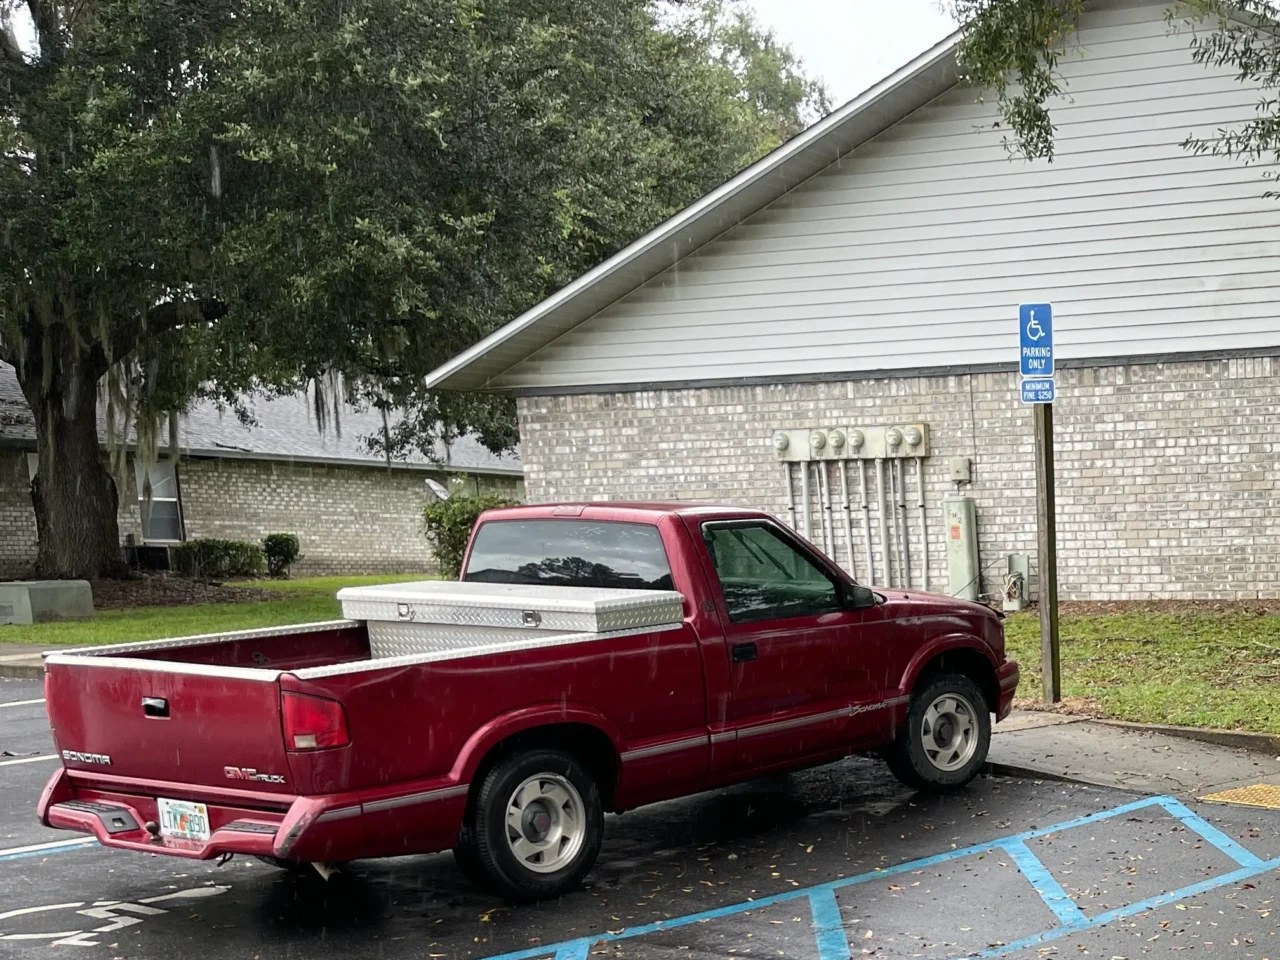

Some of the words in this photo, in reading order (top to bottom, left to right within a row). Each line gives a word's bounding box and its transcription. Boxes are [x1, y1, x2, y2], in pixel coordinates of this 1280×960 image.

[1022, 347, 1051, 357] PARKING
[1028, 359, 1046, 369] ONLY
[1025, 382, 1050, 390] MINIMUM
[1023, 391, 1036, 400] FINE
[1038, 391, 1053, 400] $250
[62, 749, 111, 765] SONOMA
[224, 766, 257, 780] GMC
